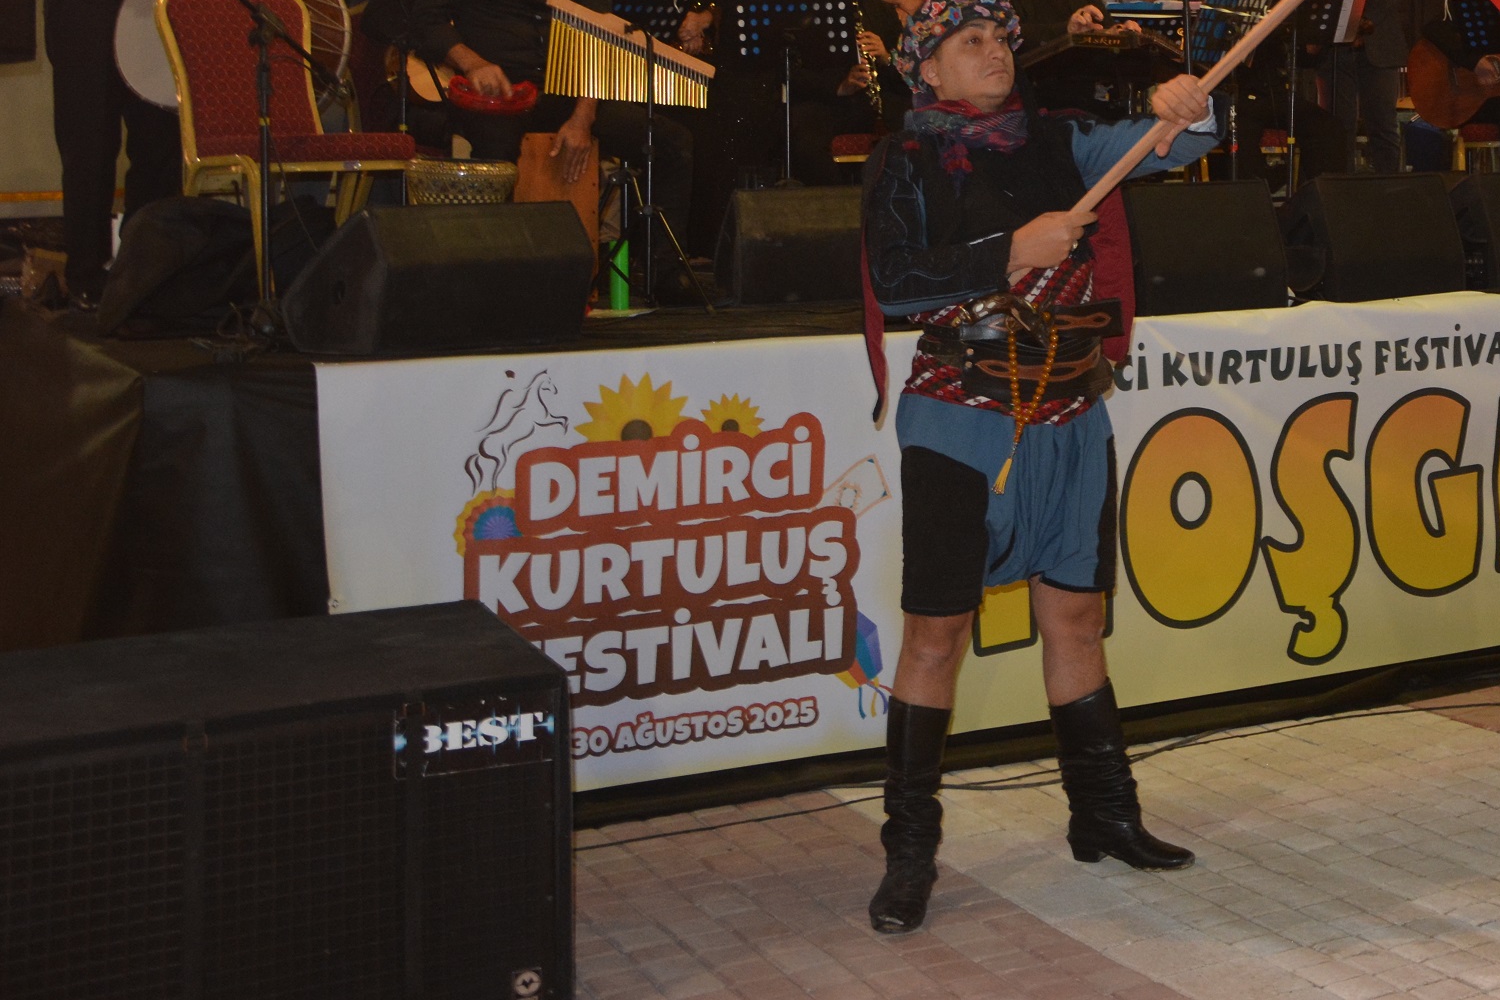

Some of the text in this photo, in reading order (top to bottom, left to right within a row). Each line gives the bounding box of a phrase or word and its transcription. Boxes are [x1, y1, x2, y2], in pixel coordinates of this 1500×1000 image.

[1162, 341, 1362, 386] KURTULUŞ
[529, 425, 813, 522] DEMİRCİ
[477, 519, 848, 615] KURTULUŞ
[529, 591, 845, 695] ESTİVALİ
[572, 699, 817, 757] 30 AĞUSTOS 2025
